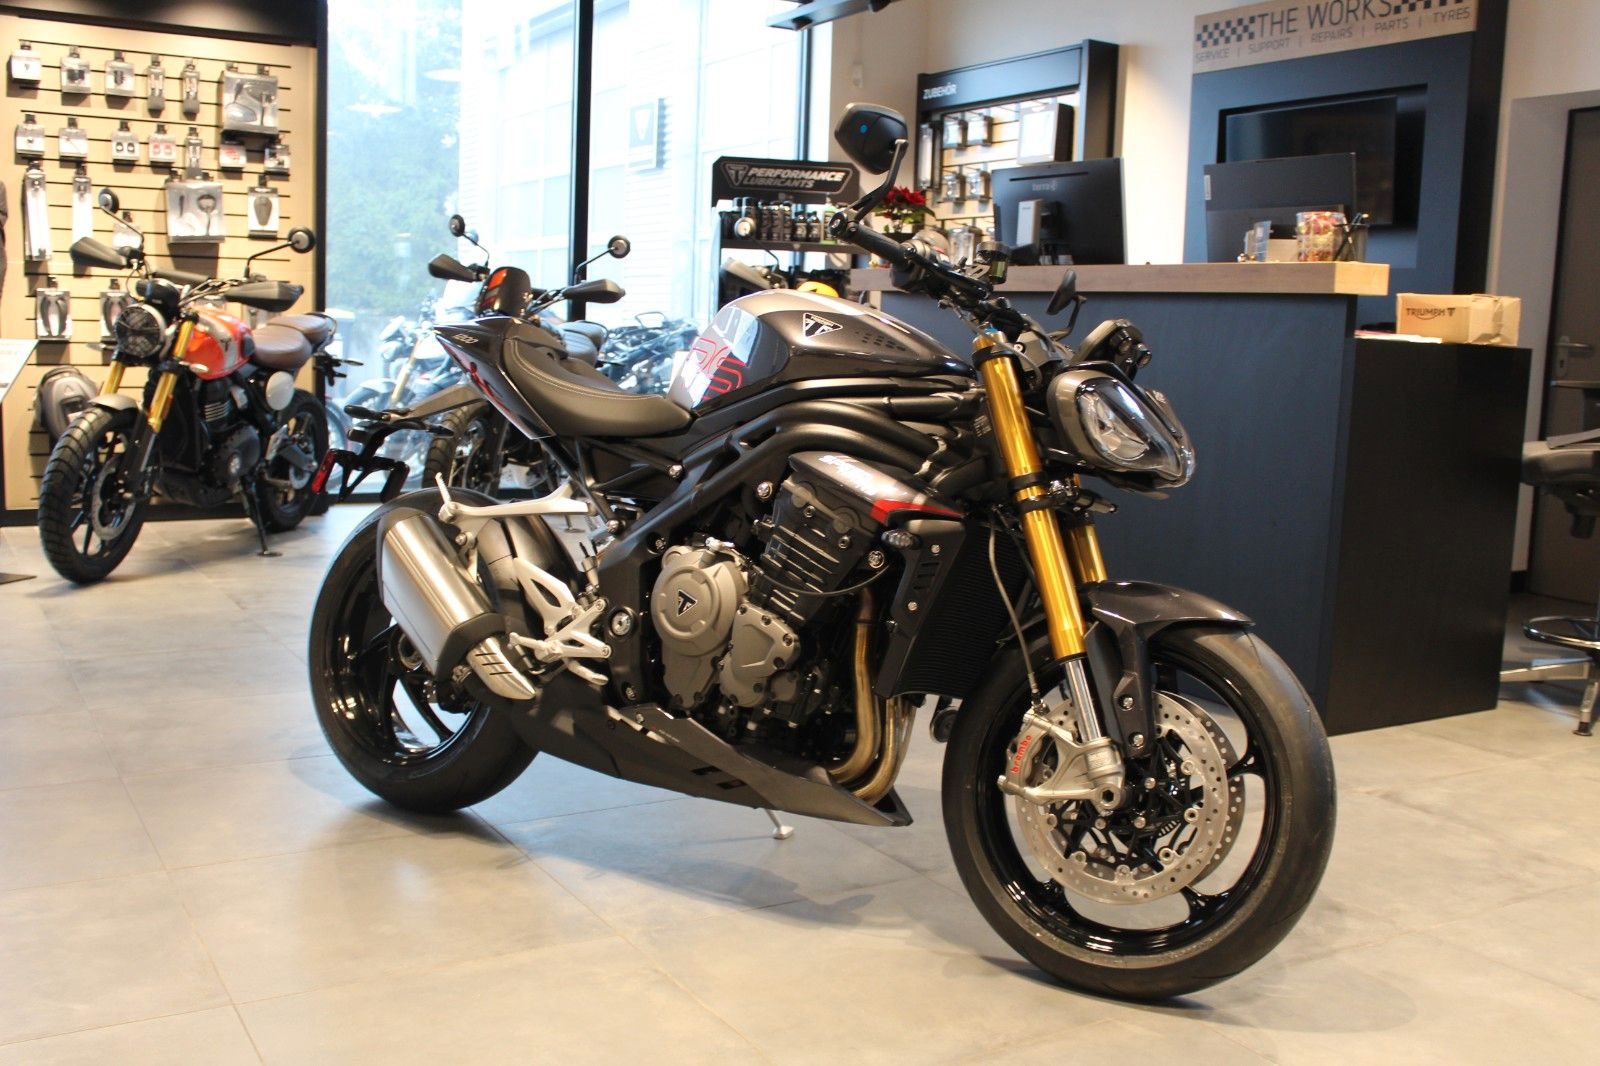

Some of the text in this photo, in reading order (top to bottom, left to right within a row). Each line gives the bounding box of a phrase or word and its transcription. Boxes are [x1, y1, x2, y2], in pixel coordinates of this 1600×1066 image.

[1257, 0, 1392, 37] THE WORKS
[1195, 7, 1471, 62] SERVICE SUPPORT REPAIRS PARTS TYRES
[923, 82, 957, 99] ZUBEHÖR
[743, 177, 816, 188] LUBRICANTS
[747, 167, 846, 181] PERFORMANCE
[1406, 307, 1446, 317] TRIUMPH
[1010, 735, 1032, 775] brembo
